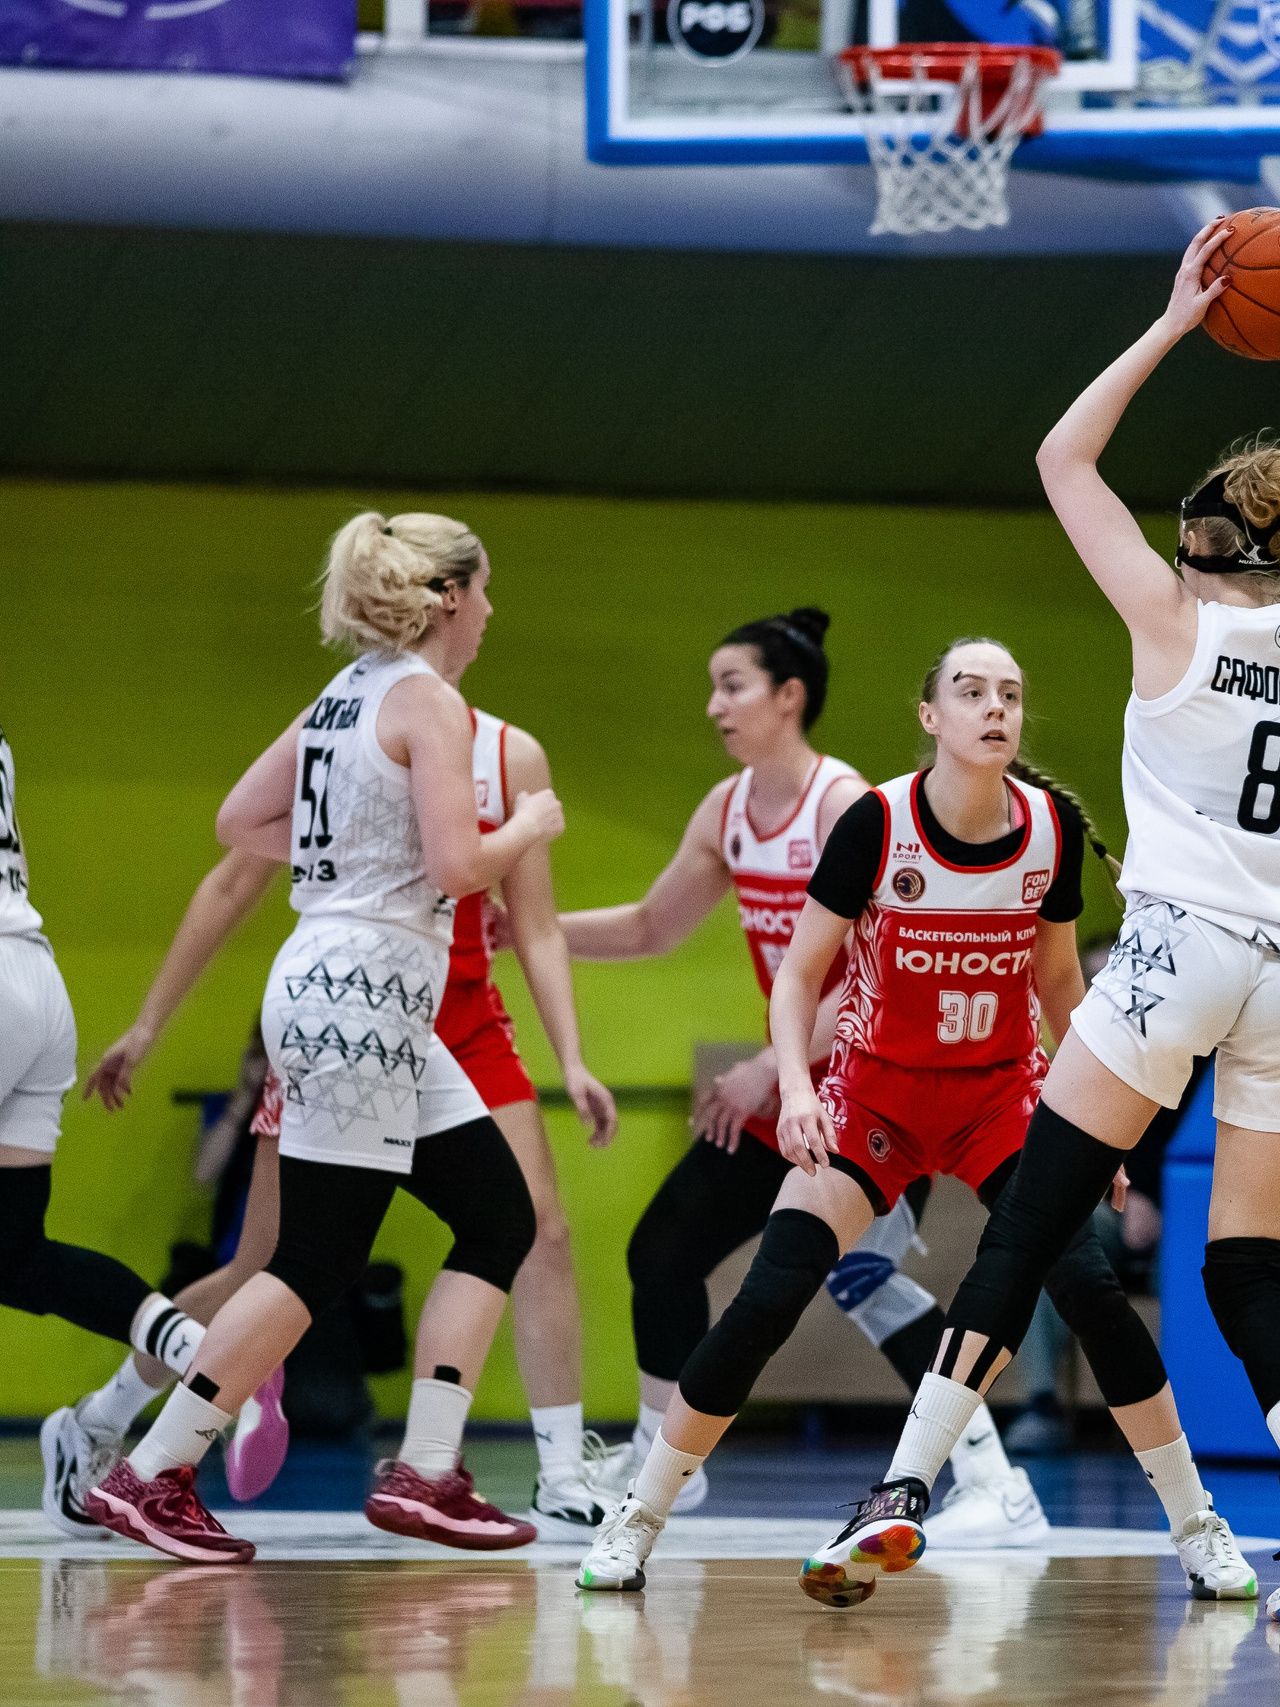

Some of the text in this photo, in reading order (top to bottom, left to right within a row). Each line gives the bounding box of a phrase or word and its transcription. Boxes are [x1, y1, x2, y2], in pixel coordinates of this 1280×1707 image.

[299, 746, 334, 849] 51
[892, 852, 923, 860] SPORT
[1024, 872, 1049, 888] FON
[899, 926, 1011, 942] БАСКЕТБОЛЬНЫЙ
[937, 990, 999, 1044] 30
